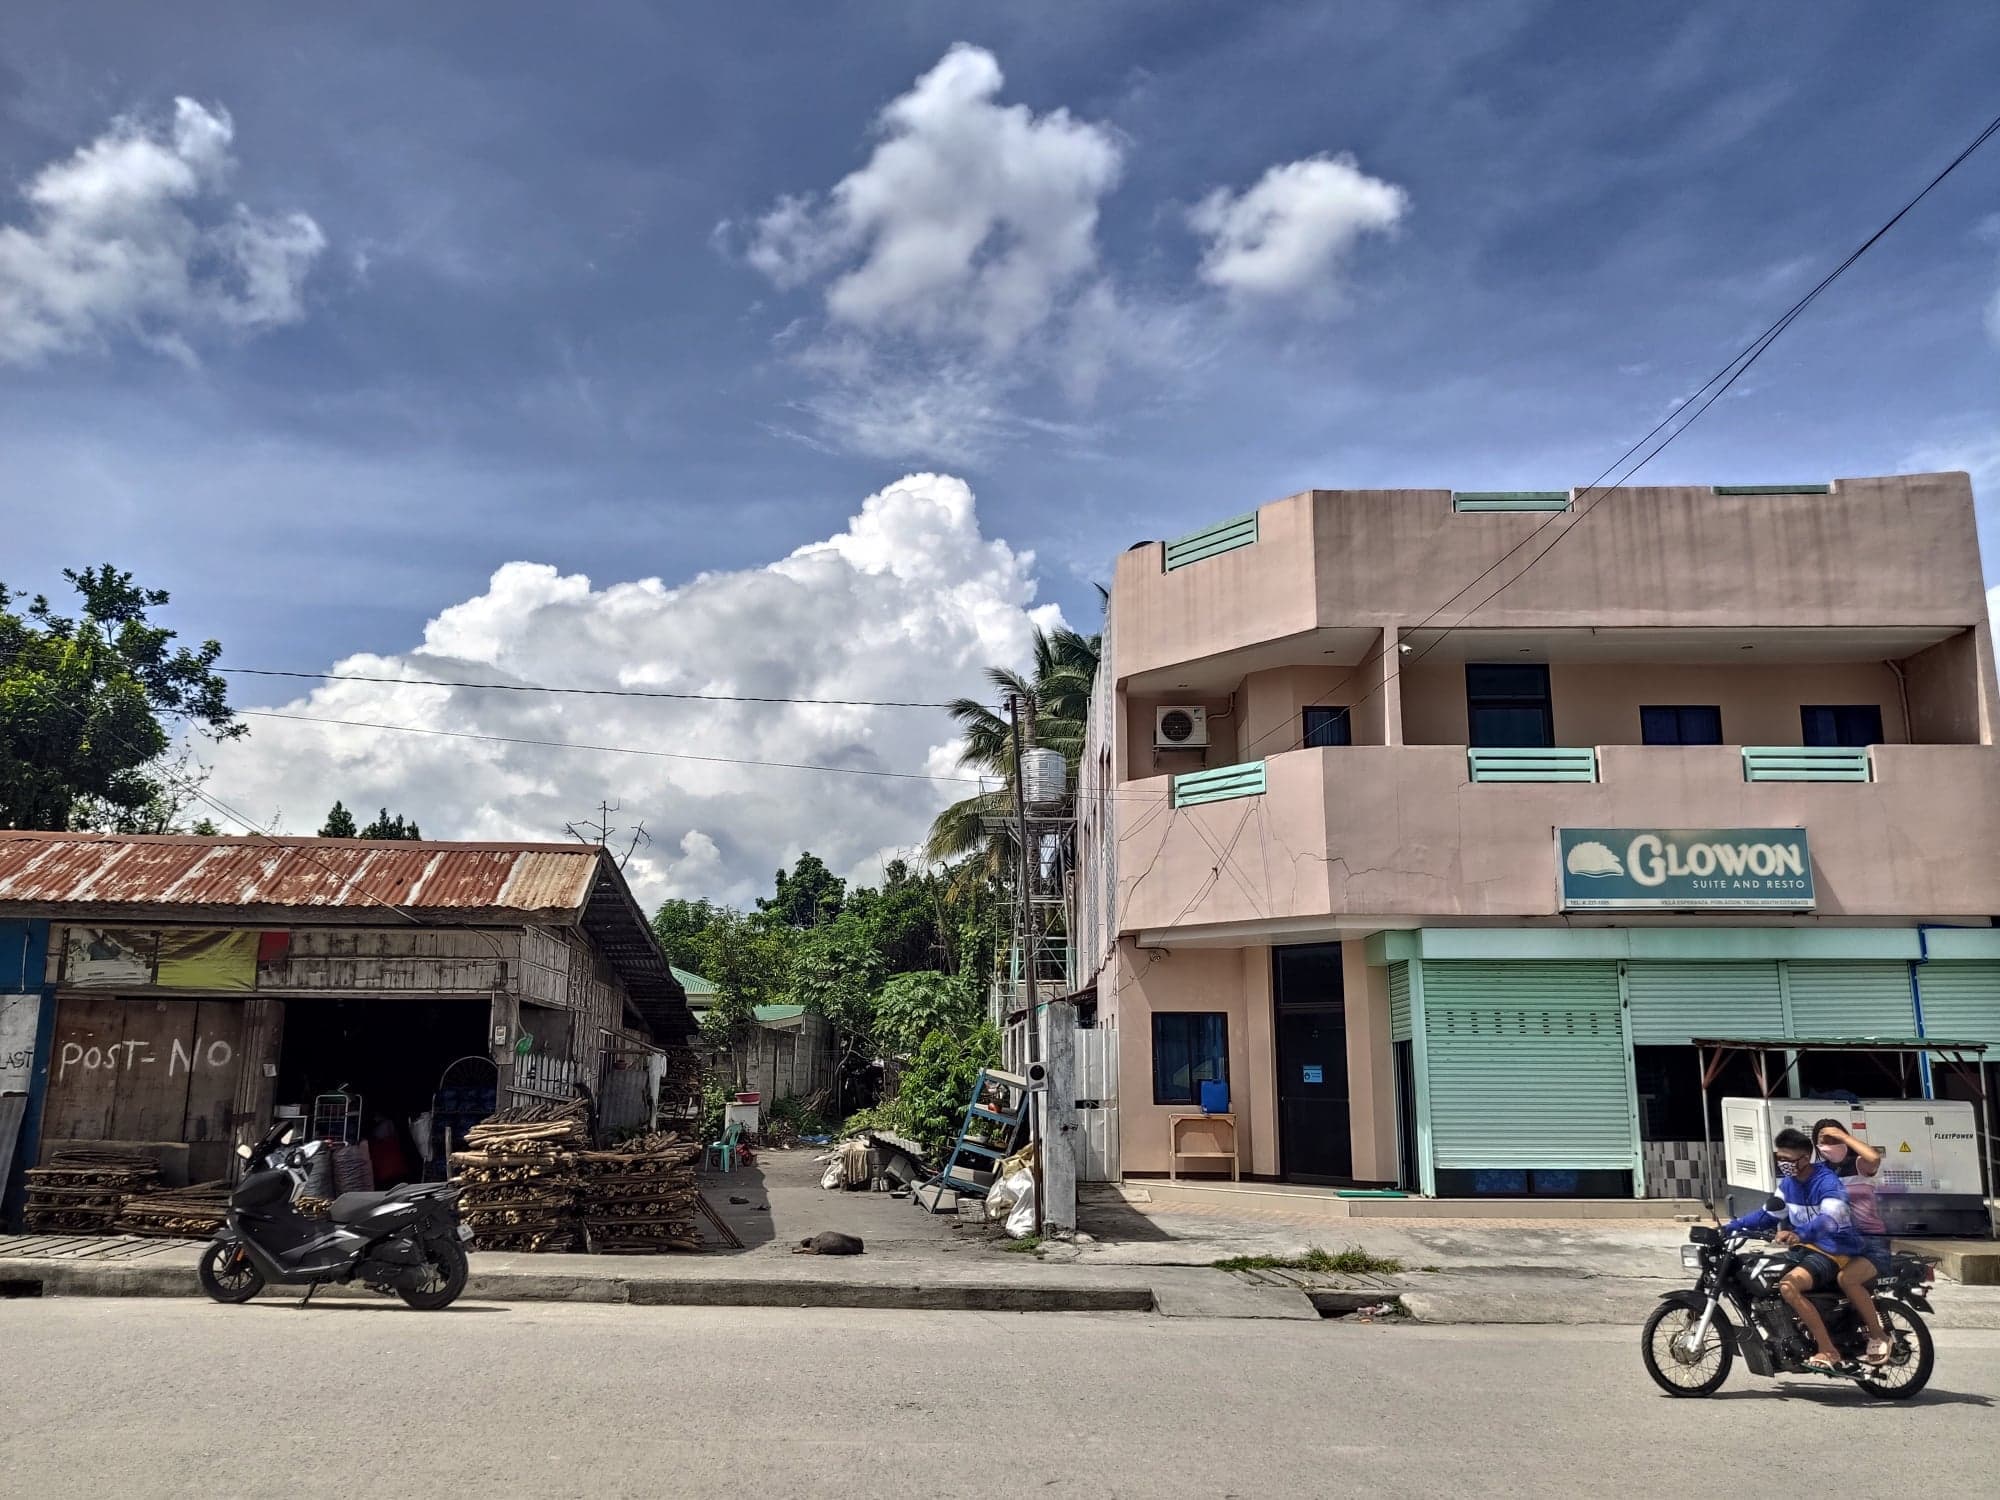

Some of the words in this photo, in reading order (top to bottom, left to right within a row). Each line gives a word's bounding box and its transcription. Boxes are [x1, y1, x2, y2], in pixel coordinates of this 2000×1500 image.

[1627, 834, 1804, 887] GLOWON
[1692, 880, 1727, 889] SUITE
[1733, 880, 1760, 889] AND
[1766, 880, 1806, 889] RESTO
[168, 1036, 232, 1077] NO
